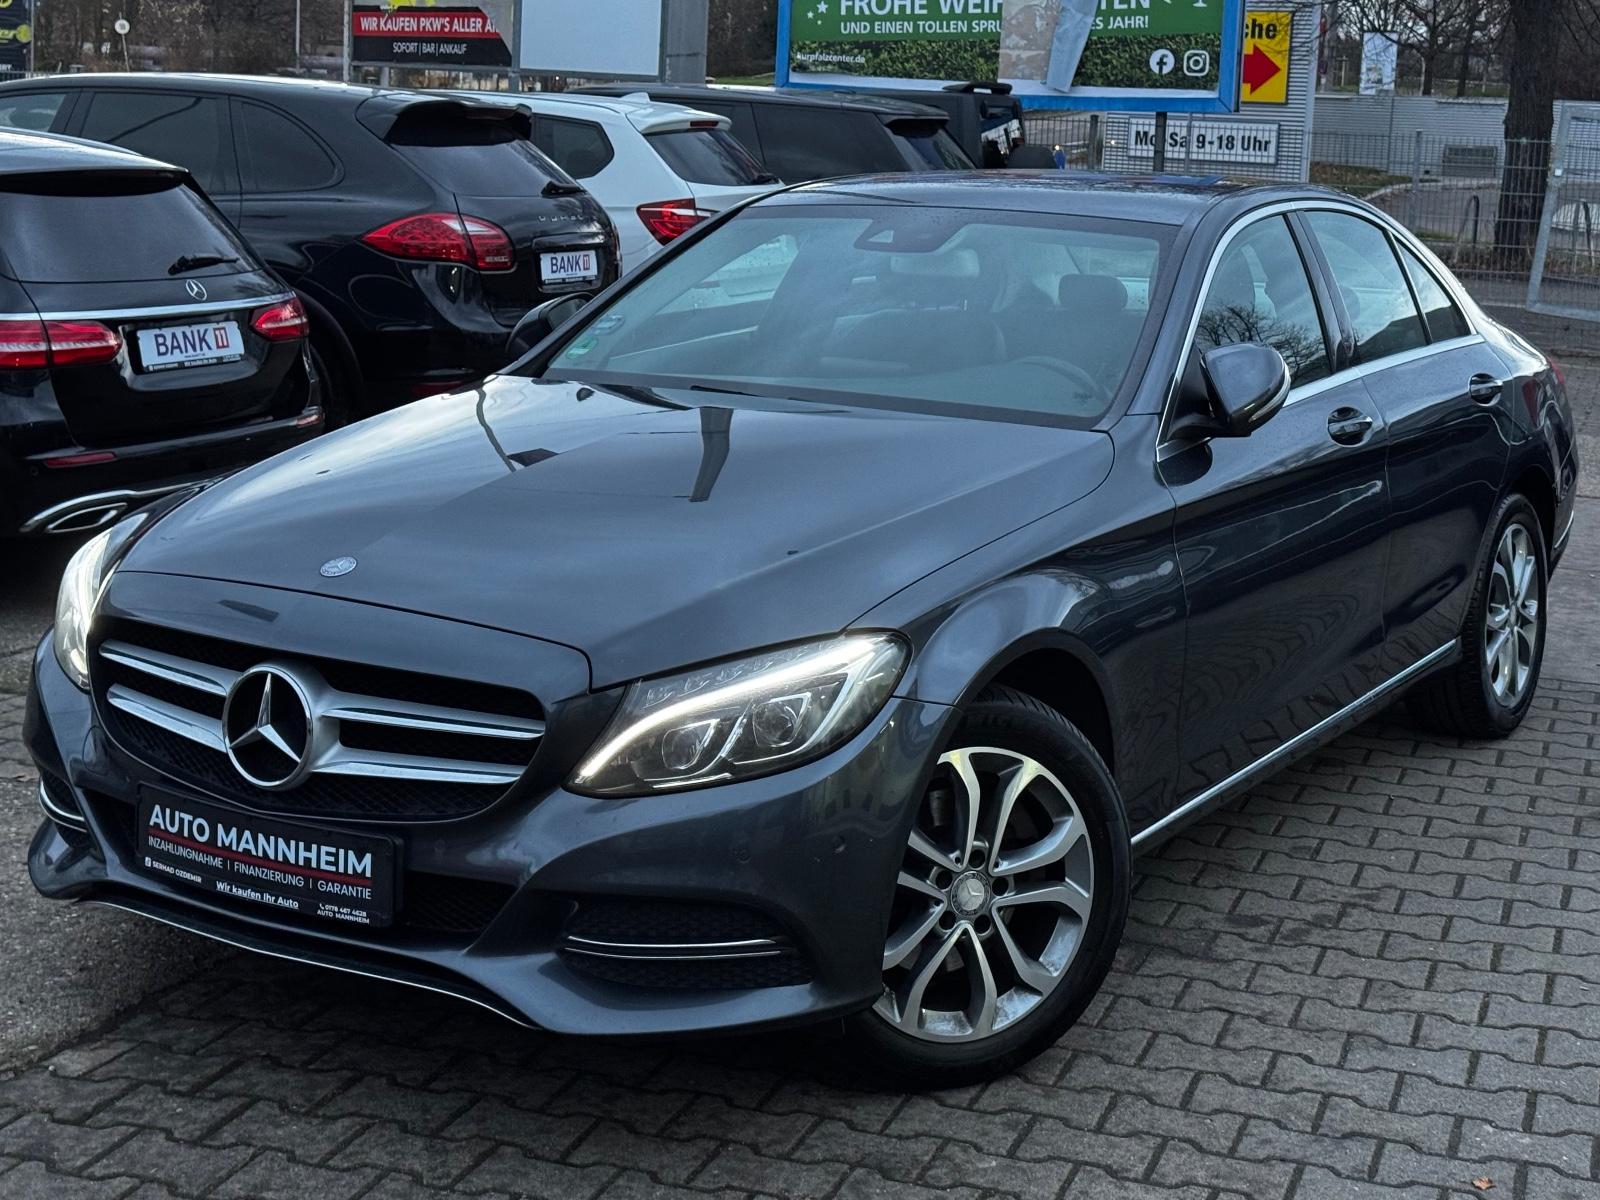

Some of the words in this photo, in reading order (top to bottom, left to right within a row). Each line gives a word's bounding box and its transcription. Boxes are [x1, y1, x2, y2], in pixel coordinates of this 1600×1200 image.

[360, 17, 378, 31] WIR
[380, 16, 417, 32] KAUFEN
[419, 17, 449, 32] PKW'S
[452, 17, 482, 33] ALLER
[841, 21, 870, 34] UND
[874, 21, 913, 34] EINEN
[917, 20, 967, 33] TOLLEN
[1107, 15, 1149, 30] JAHR!
[392, 42, 419, 53] SOFORT
[422, 43, 435, 54] BAR
[439, 43, 467, 55] ANKAUF
[1240, 136, 1271, 152] Uhr
[550, 254, 582, 274] BANK
[154, 328, 212, 357] BANK
[149, 804, 210, 843] AUTO
[217, 823, 372, 878] MANNHEIM
[148, 835, 224, 869] INZAHLUNGNAHME
[234, 861, 305, 887] FINANZIERUNG
[317, 880, 372, 900] GARANTIE
[216, 881, 231, 892] Wir
[232, 883, 261, 900] kaufen
[263, 892, 275, 904] Ihr
[277, 896, 299, 909] Auto
